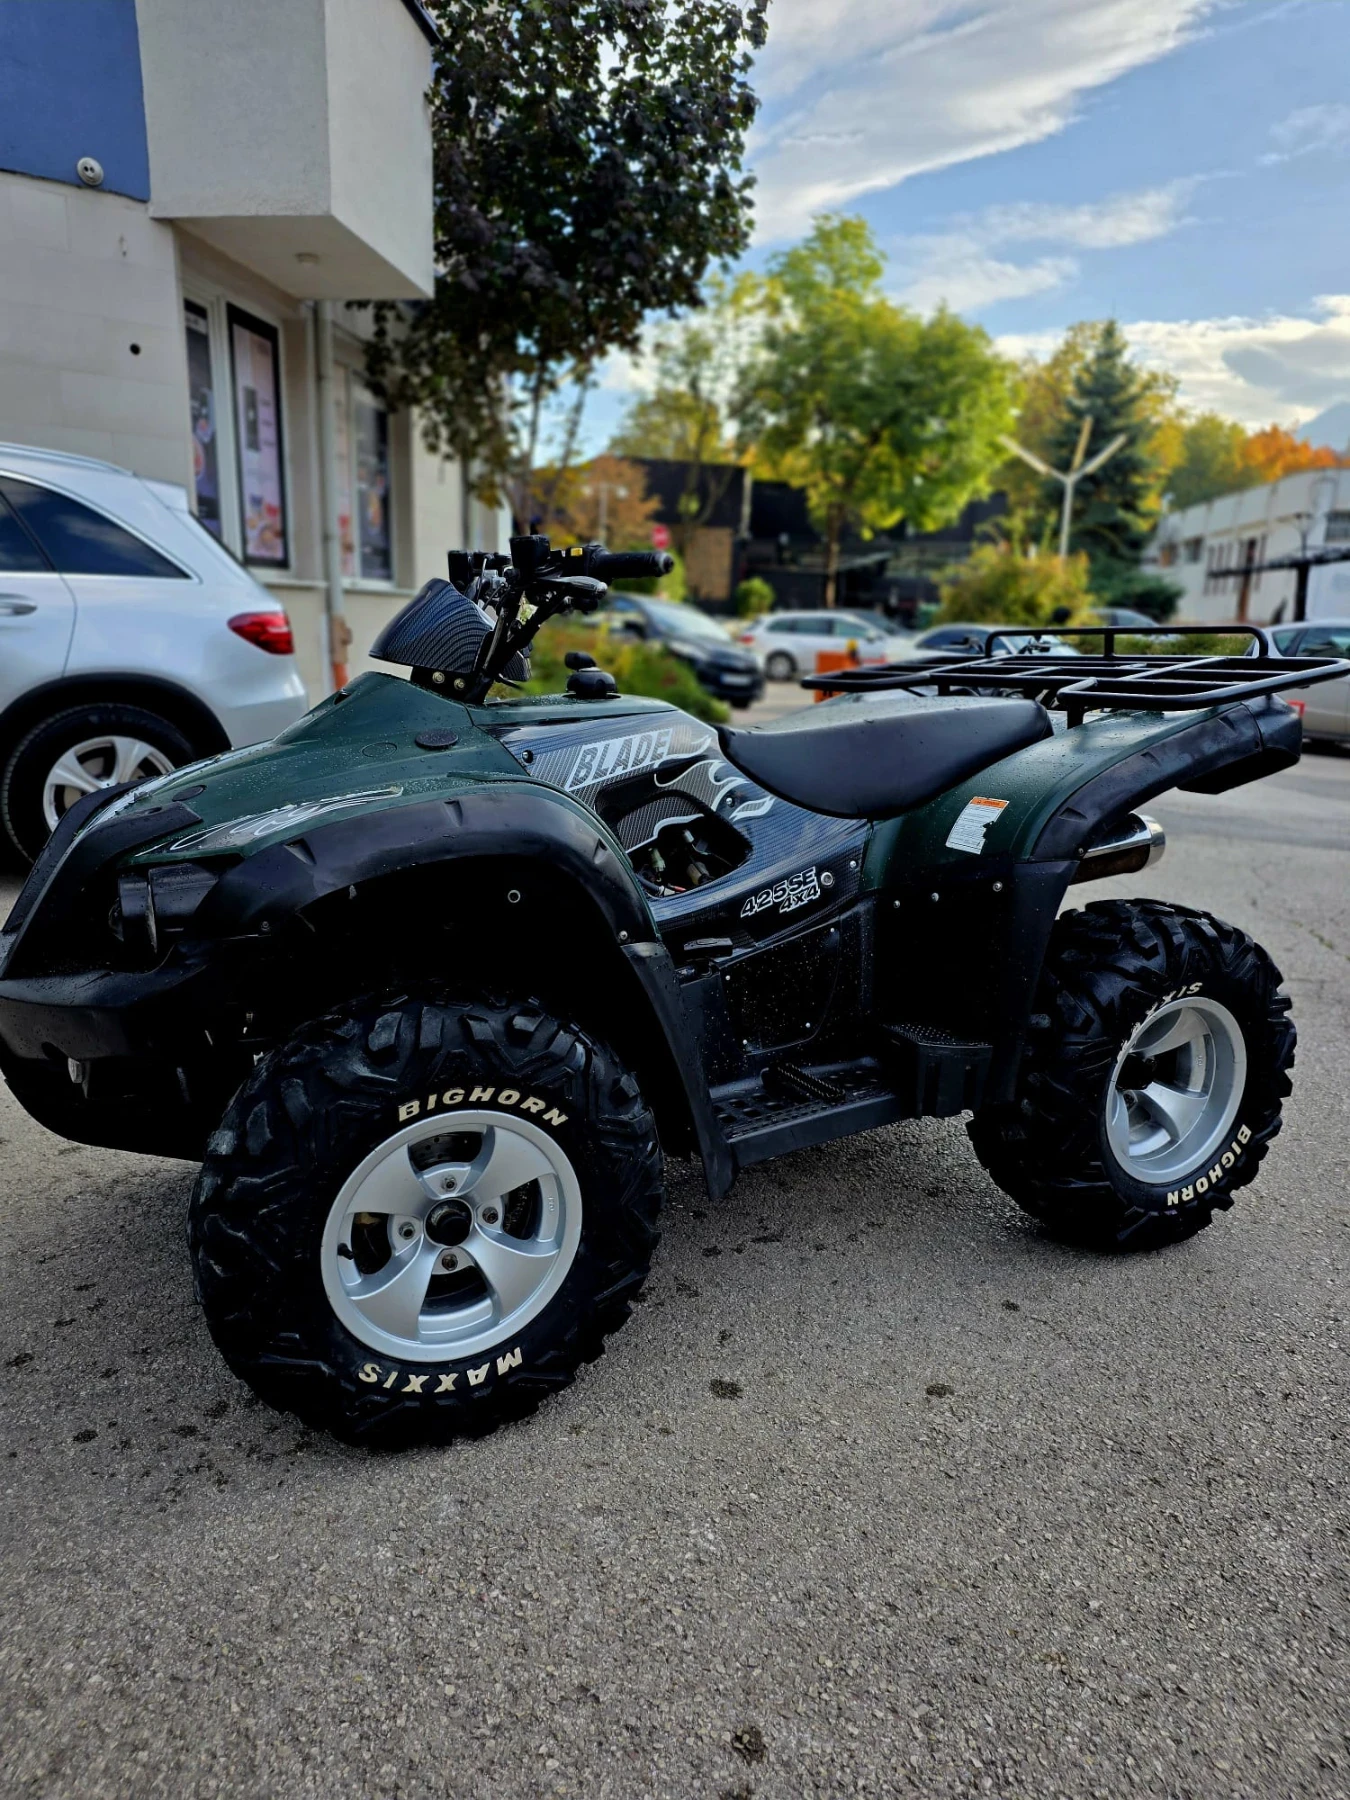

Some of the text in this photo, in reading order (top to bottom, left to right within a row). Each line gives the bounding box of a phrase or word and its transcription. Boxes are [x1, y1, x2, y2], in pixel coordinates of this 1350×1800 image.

[568, 729, 671, 789] BLADE
[740, 866, 817, 917] 425SE
[398, 1086, 569, 1126] BIGHORN
[1167, 1124, 1252, 1206] BIGHORN
[358, 1346, 523, 1393] MAXXIS
